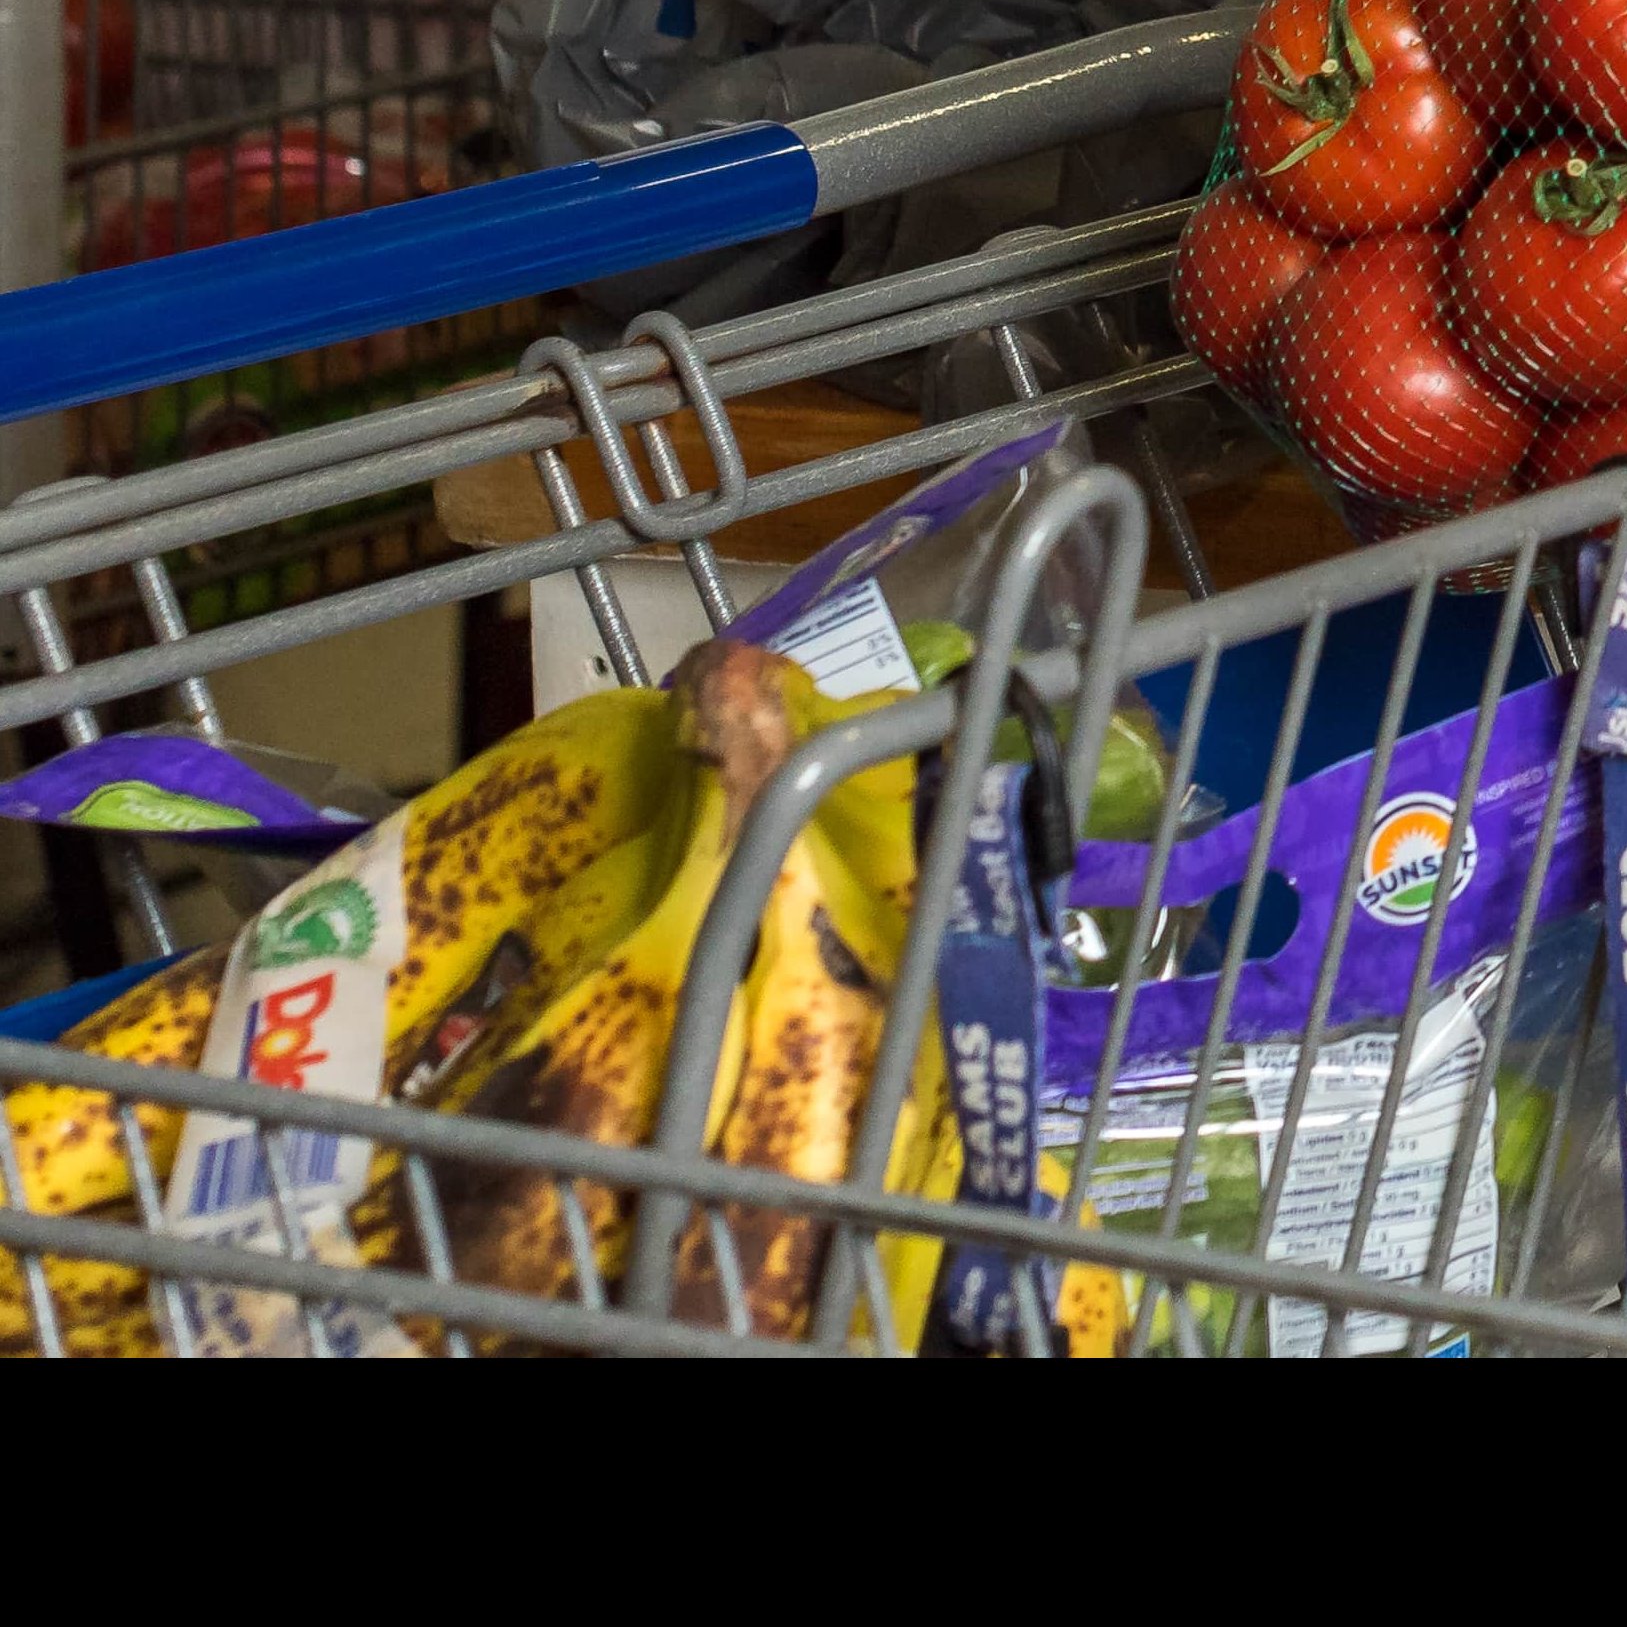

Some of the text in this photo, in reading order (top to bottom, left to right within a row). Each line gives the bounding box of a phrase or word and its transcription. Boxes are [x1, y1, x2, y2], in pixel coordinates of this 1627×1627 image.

[1362, 846, 1477, 906] SUNST
[951, 1022, 994, 1197] SAMS
[993, 1039, 1029, 1197] CLUB
